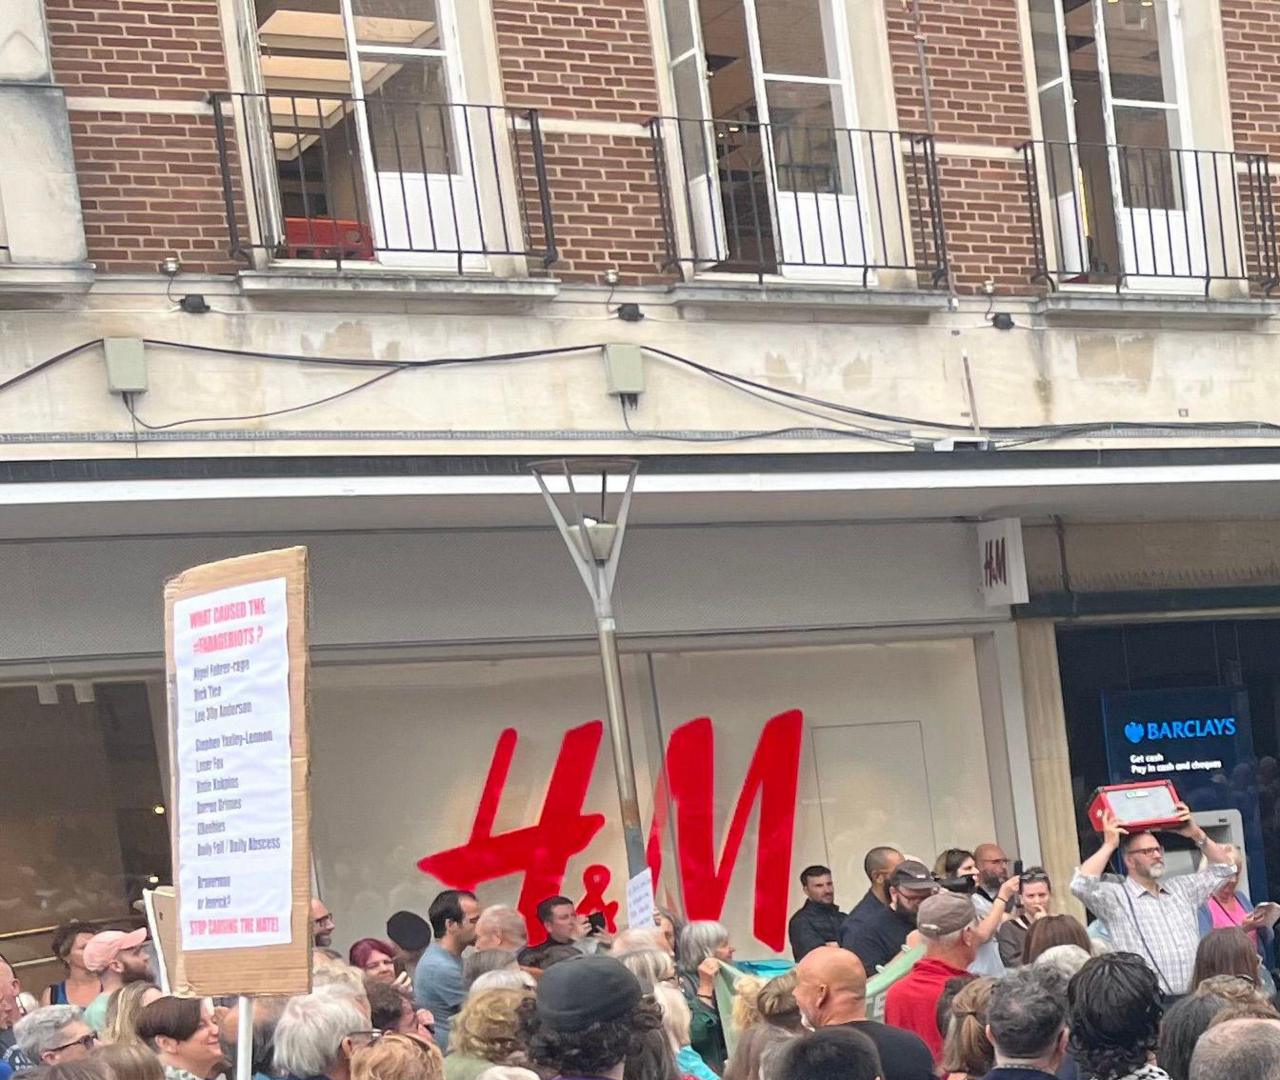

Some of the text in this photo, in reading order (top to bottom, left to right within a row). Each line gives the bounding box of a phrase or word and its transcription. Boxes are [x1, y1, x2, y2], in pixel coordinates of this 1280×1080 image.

[984, 536, 1007, 588] H&M
[190, 597, 266, 629] WHAT CAUSED THE
[219, 701, 253, 719] Anderson
[1147, 717, 1236, 741] BARCLAYS
[1130, 753, 1164, 764] Get cash
[1130, 760, 1222, 776] Pay in cash and cheques
[416, 708, 804, 954] H&M
[247, 837, 281, 852] Abscess
[190, 919, 208, 936] STOP
[240, 917, 254, 934] THE
